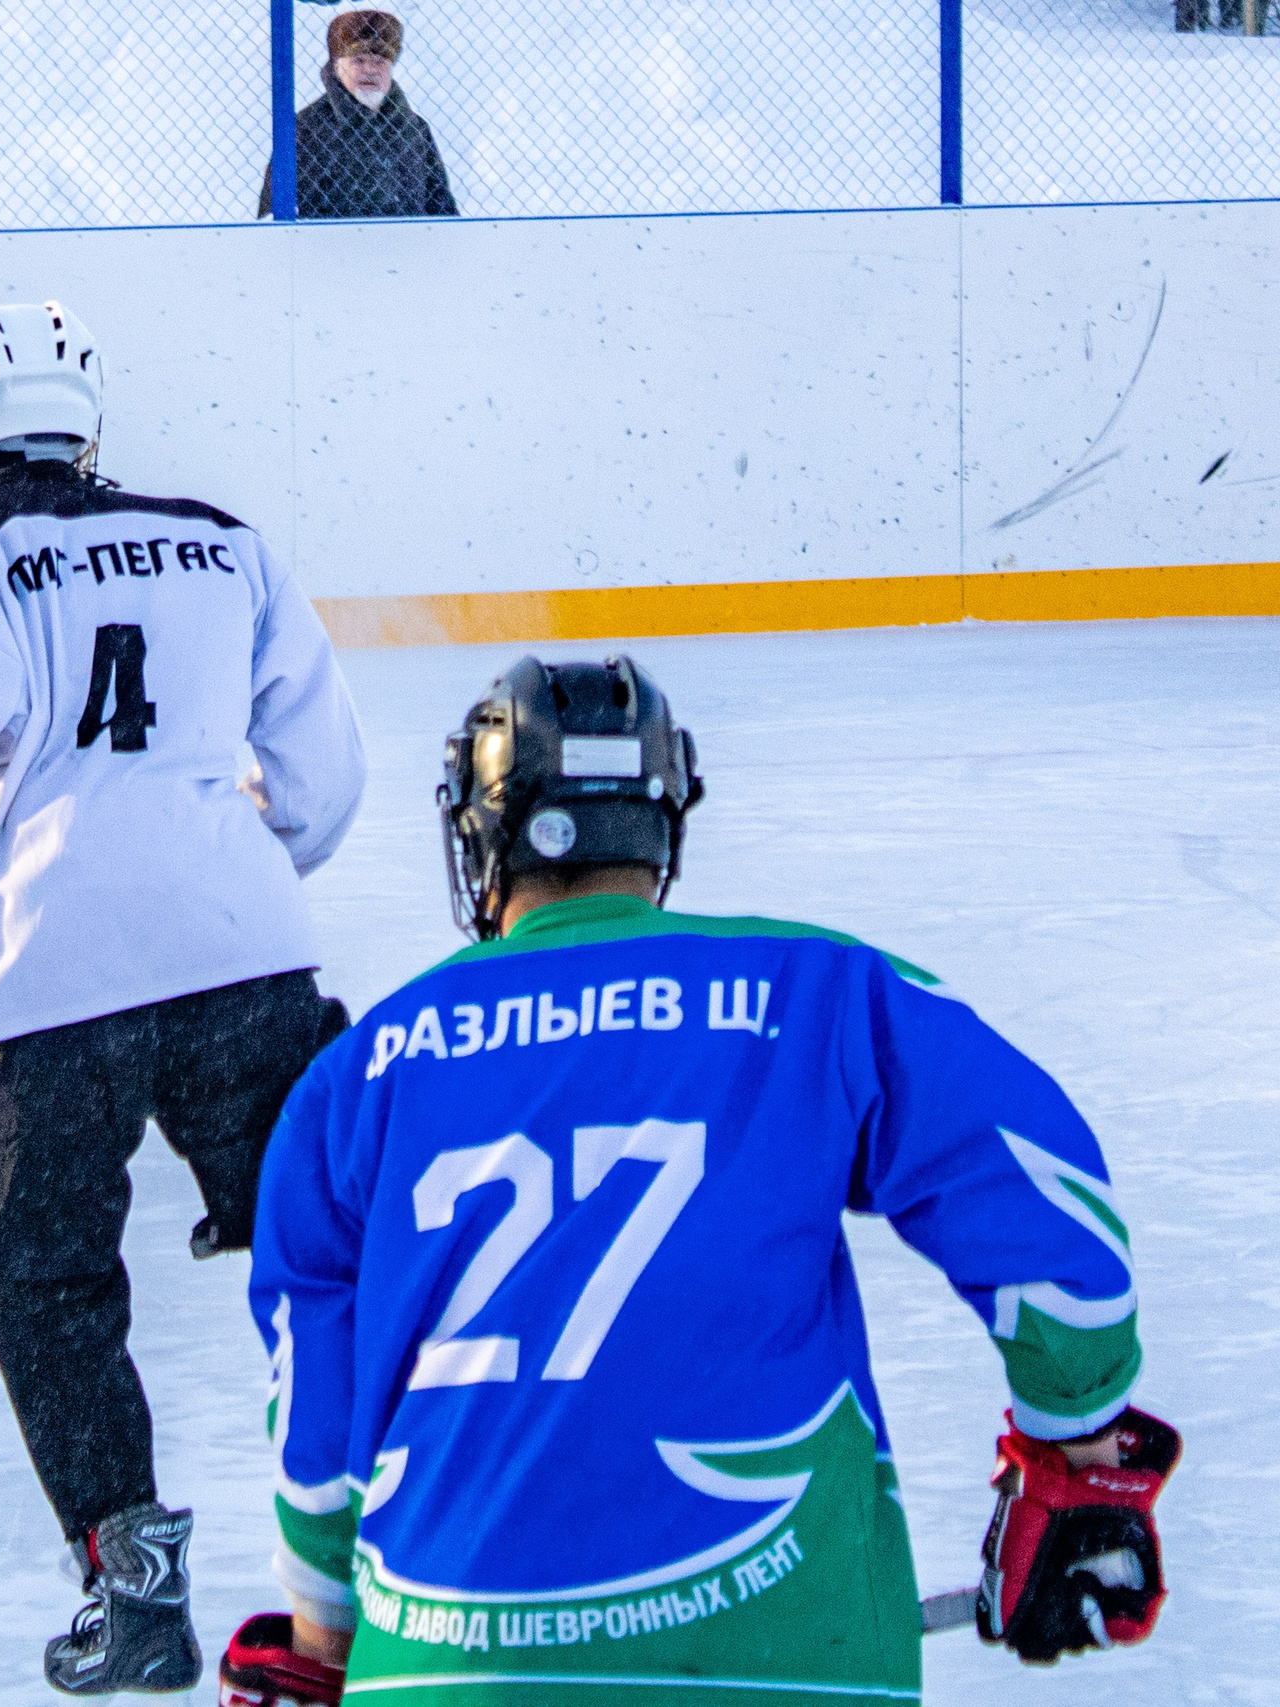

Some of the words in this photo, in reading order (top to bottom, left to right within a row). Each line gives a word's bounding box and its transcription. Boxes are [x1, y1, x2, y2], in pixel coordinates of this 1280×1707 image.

[77, 623, 157, 753] 4
[408, 1117, 706, 1391] 27
[402, 1601, 489, 1652] ЗАВОД
[499, 1577, 731, 1647] ШЕВРОННЫХ
[732, 1528, 804, 1602] ЛЕНТ
